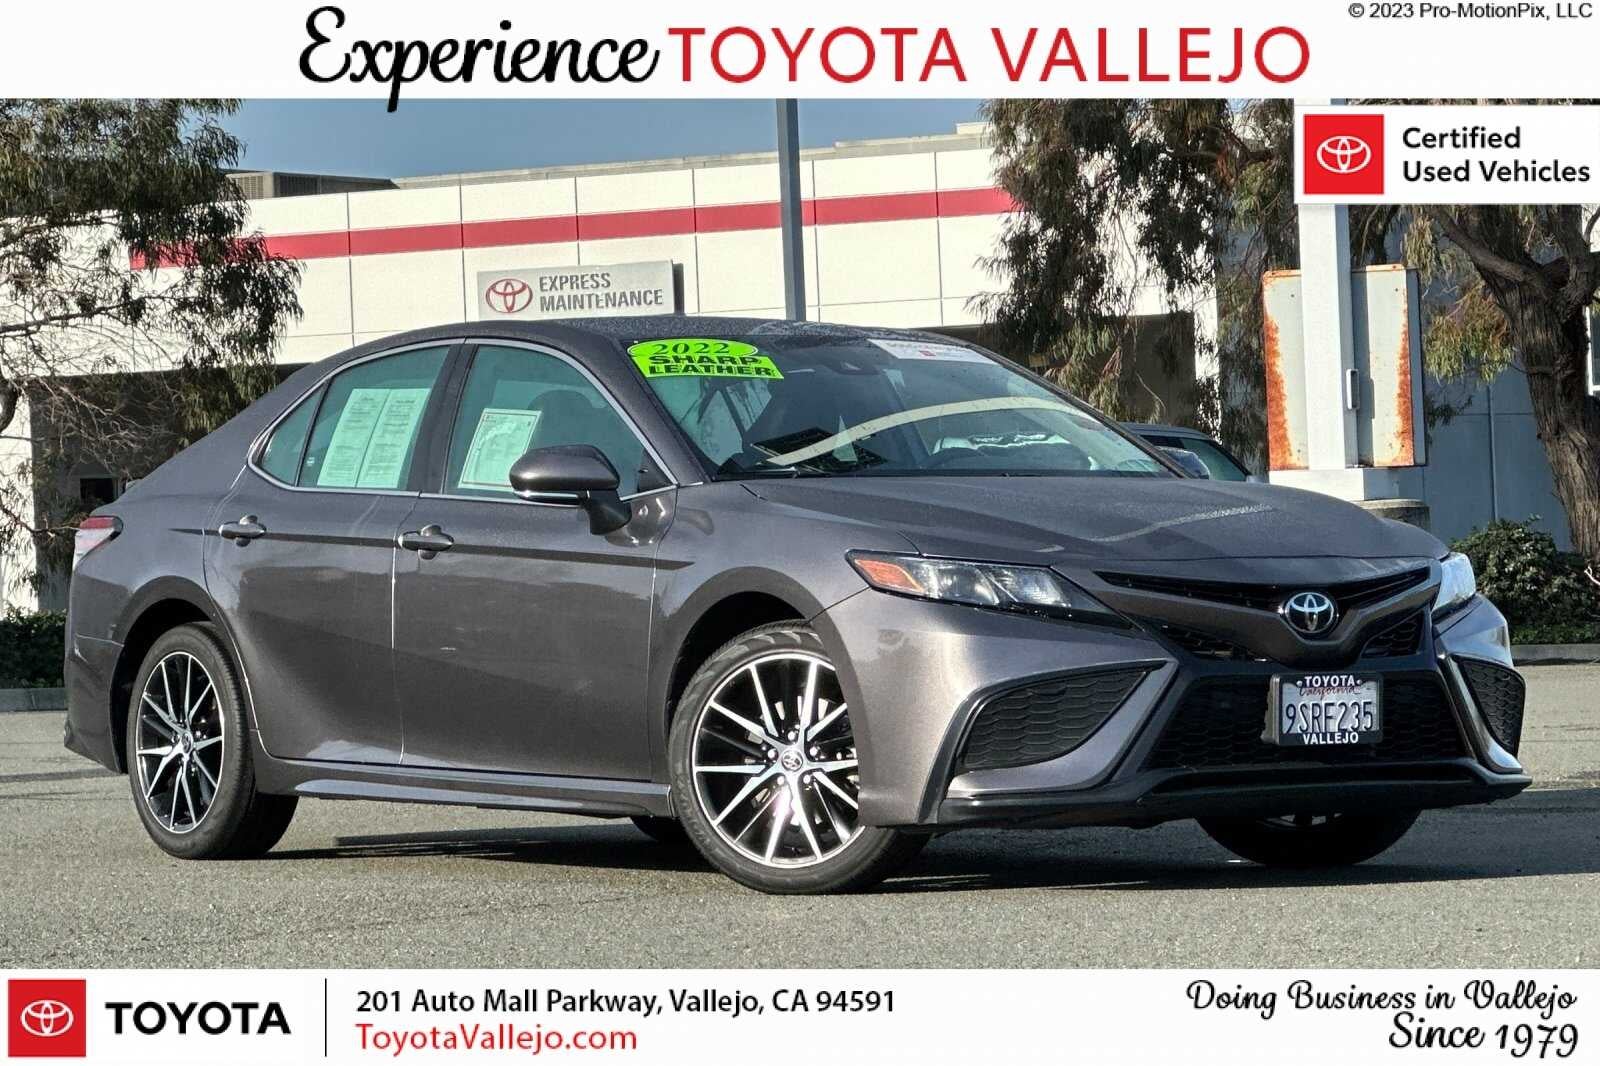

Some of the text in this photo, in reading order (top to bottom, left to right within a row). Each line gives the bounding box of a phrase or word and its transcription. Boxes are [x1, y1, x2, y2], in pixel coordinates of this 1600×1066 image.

[539, 272, 611, 292] EXPRESS
[540, 288, 663, 312] MAINTENANCE
[652, 342, 729, 354] 2022
[648, 355, 758, 365] SHARP
[649, 364, 772, 376] LEATHER
[1304, 675, 1355, 687] TOYOTA
[1285, 701, 1373, 733] 9SRF235
[1302, 732, 1359, 745] VALLEJO
